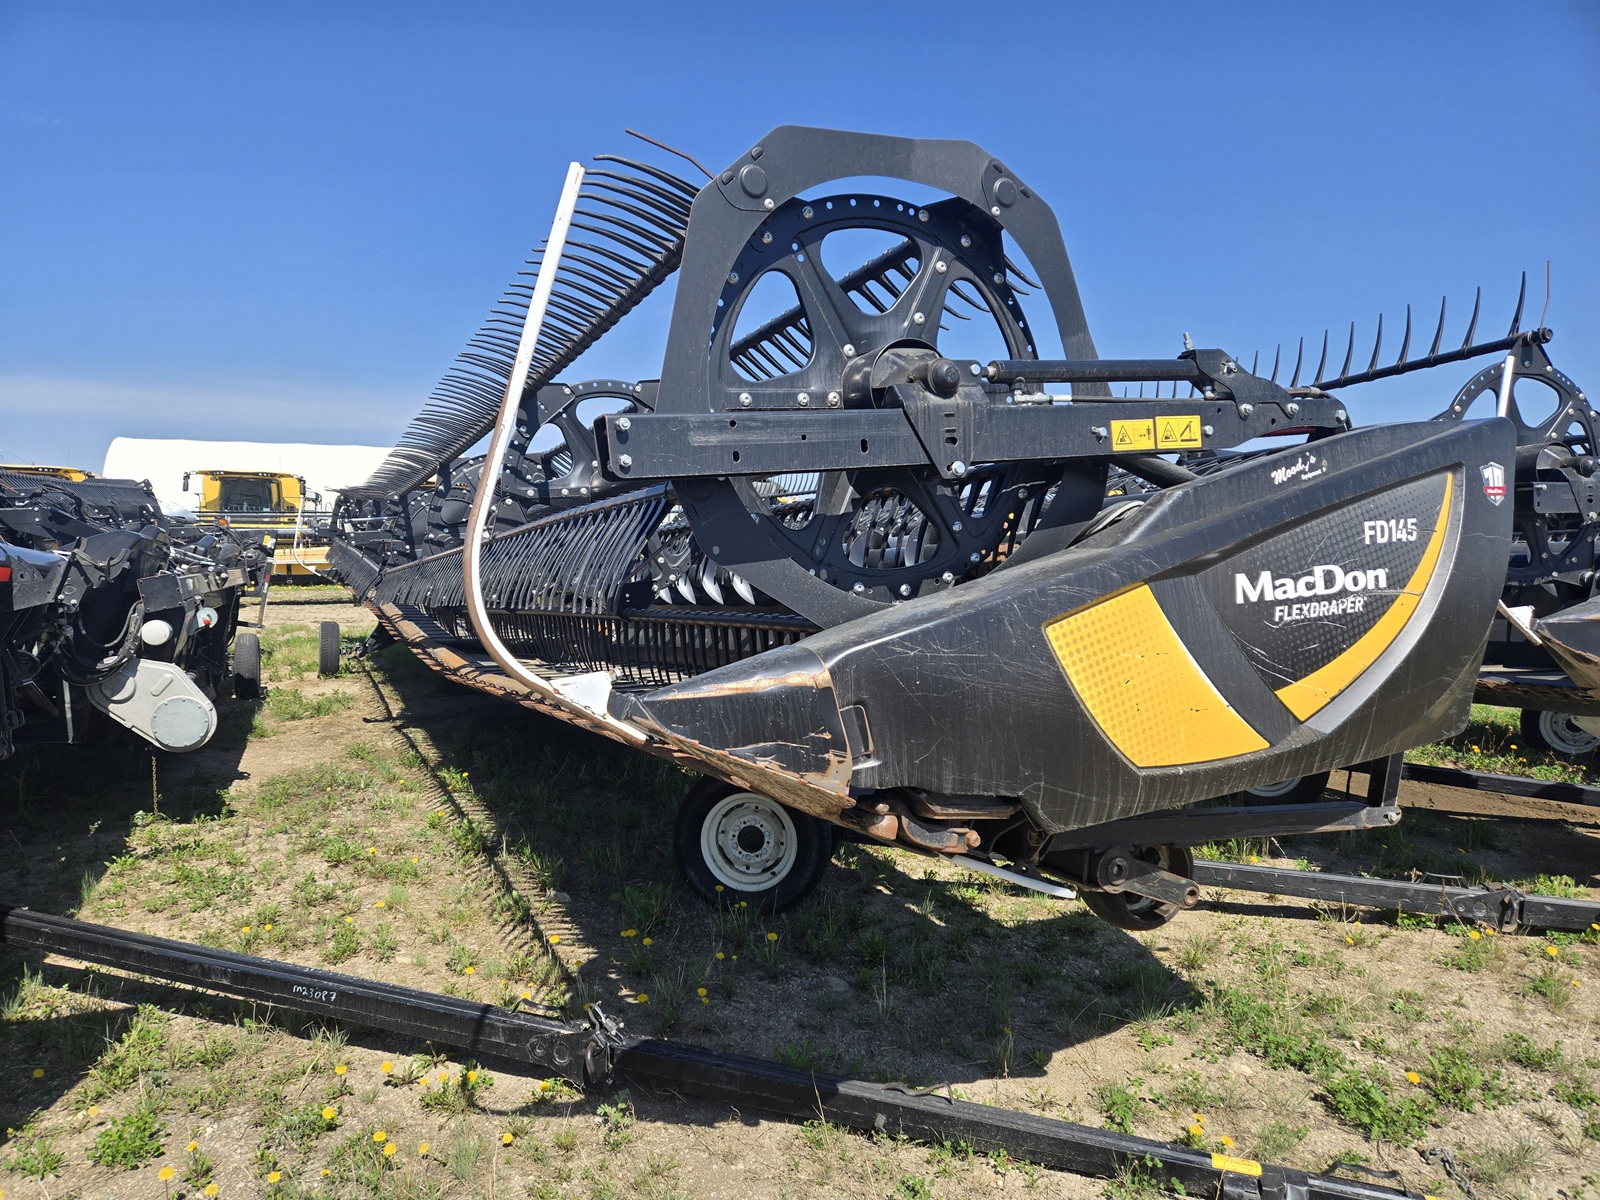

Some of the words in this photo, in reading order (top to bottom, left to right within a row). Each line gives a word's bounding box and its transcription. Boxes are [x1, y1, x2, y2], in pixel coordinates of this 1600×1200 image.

[1271, 451, 1317, 485] Moody's
[1364, 518, 1417, 544] FD145
[1235, 564, 1387, 604] MacDon
[1275, 597, 1364, 622] FLEXDRAPER
